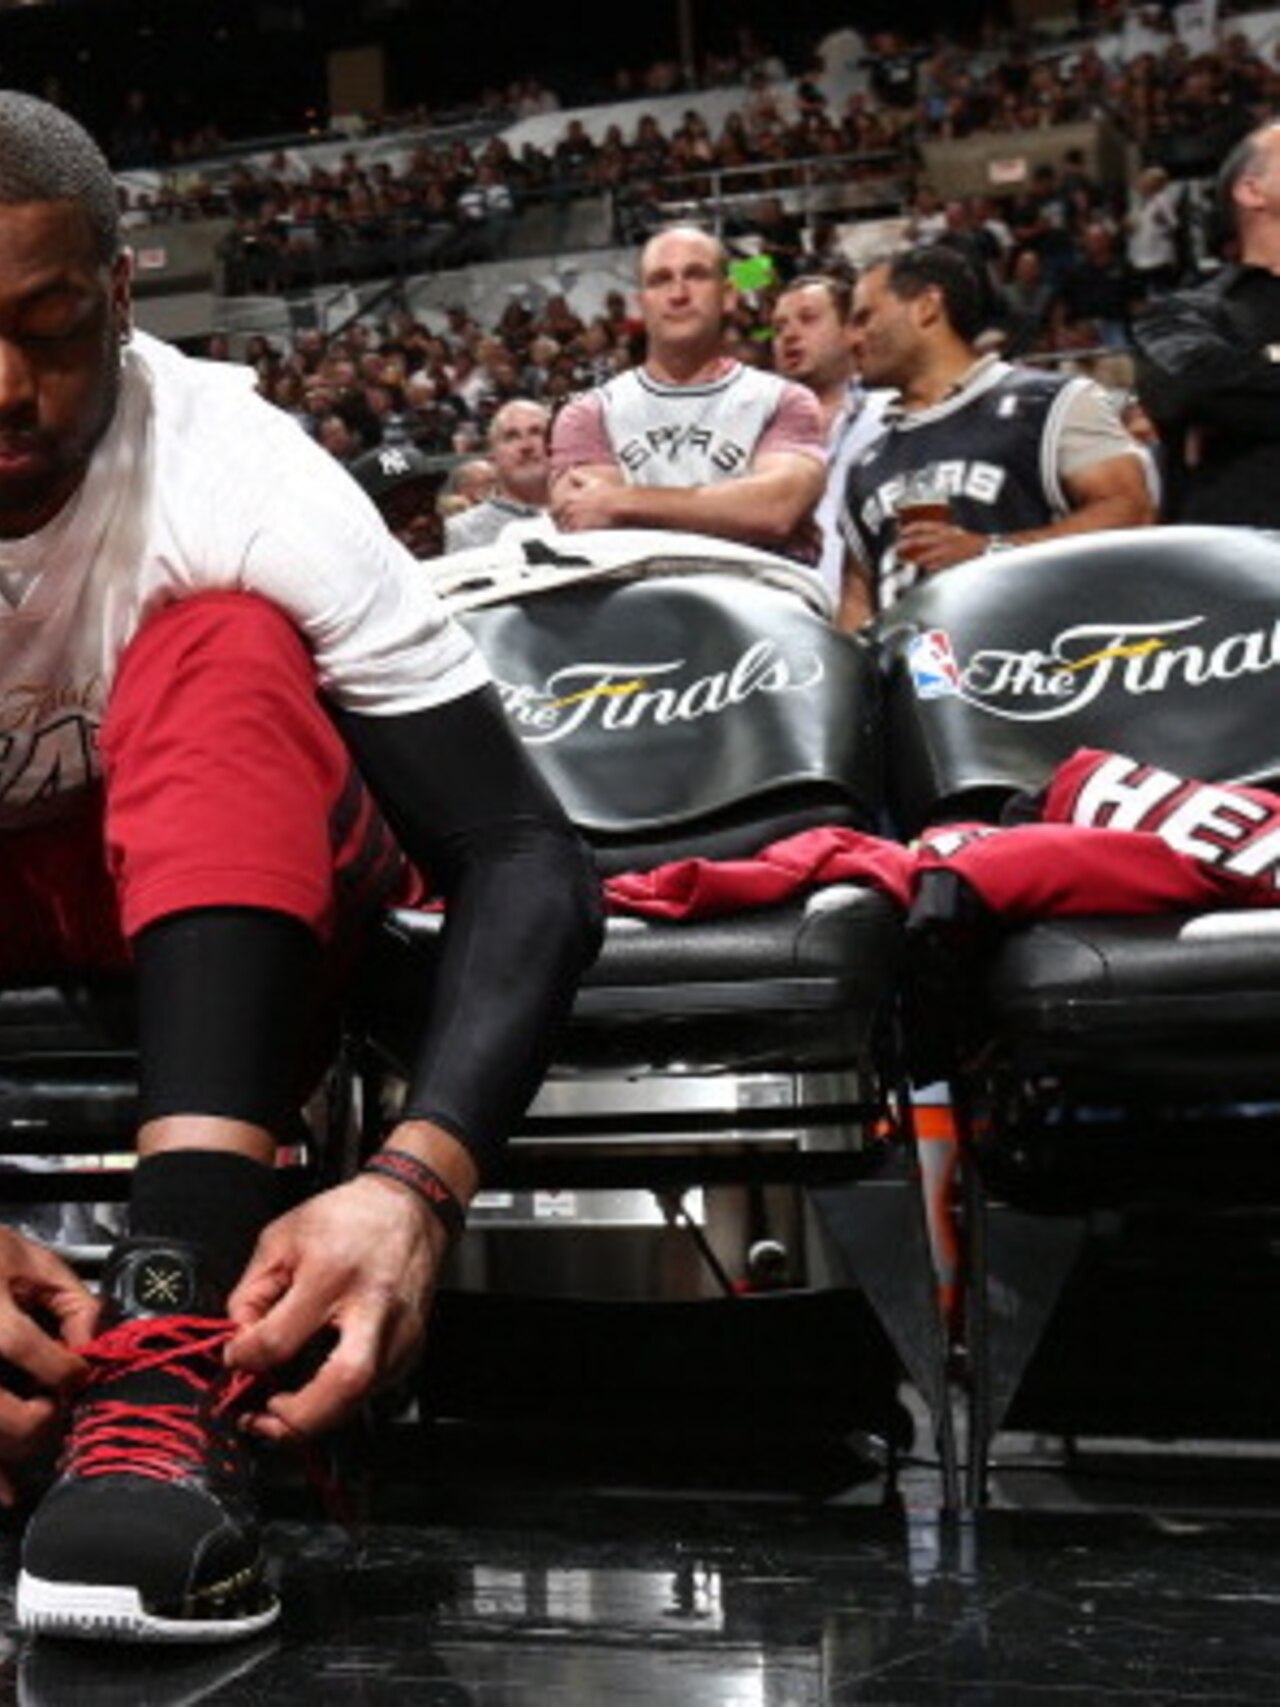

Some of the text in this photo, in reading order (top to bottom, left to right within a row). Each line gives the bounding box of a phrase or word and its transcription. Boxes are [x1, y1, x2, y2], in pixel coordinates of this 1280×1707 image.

[619, 424, 746, 472] SPURS
[522, 638, 824, 743] Finals
[963, 650, 1075, 697] The
